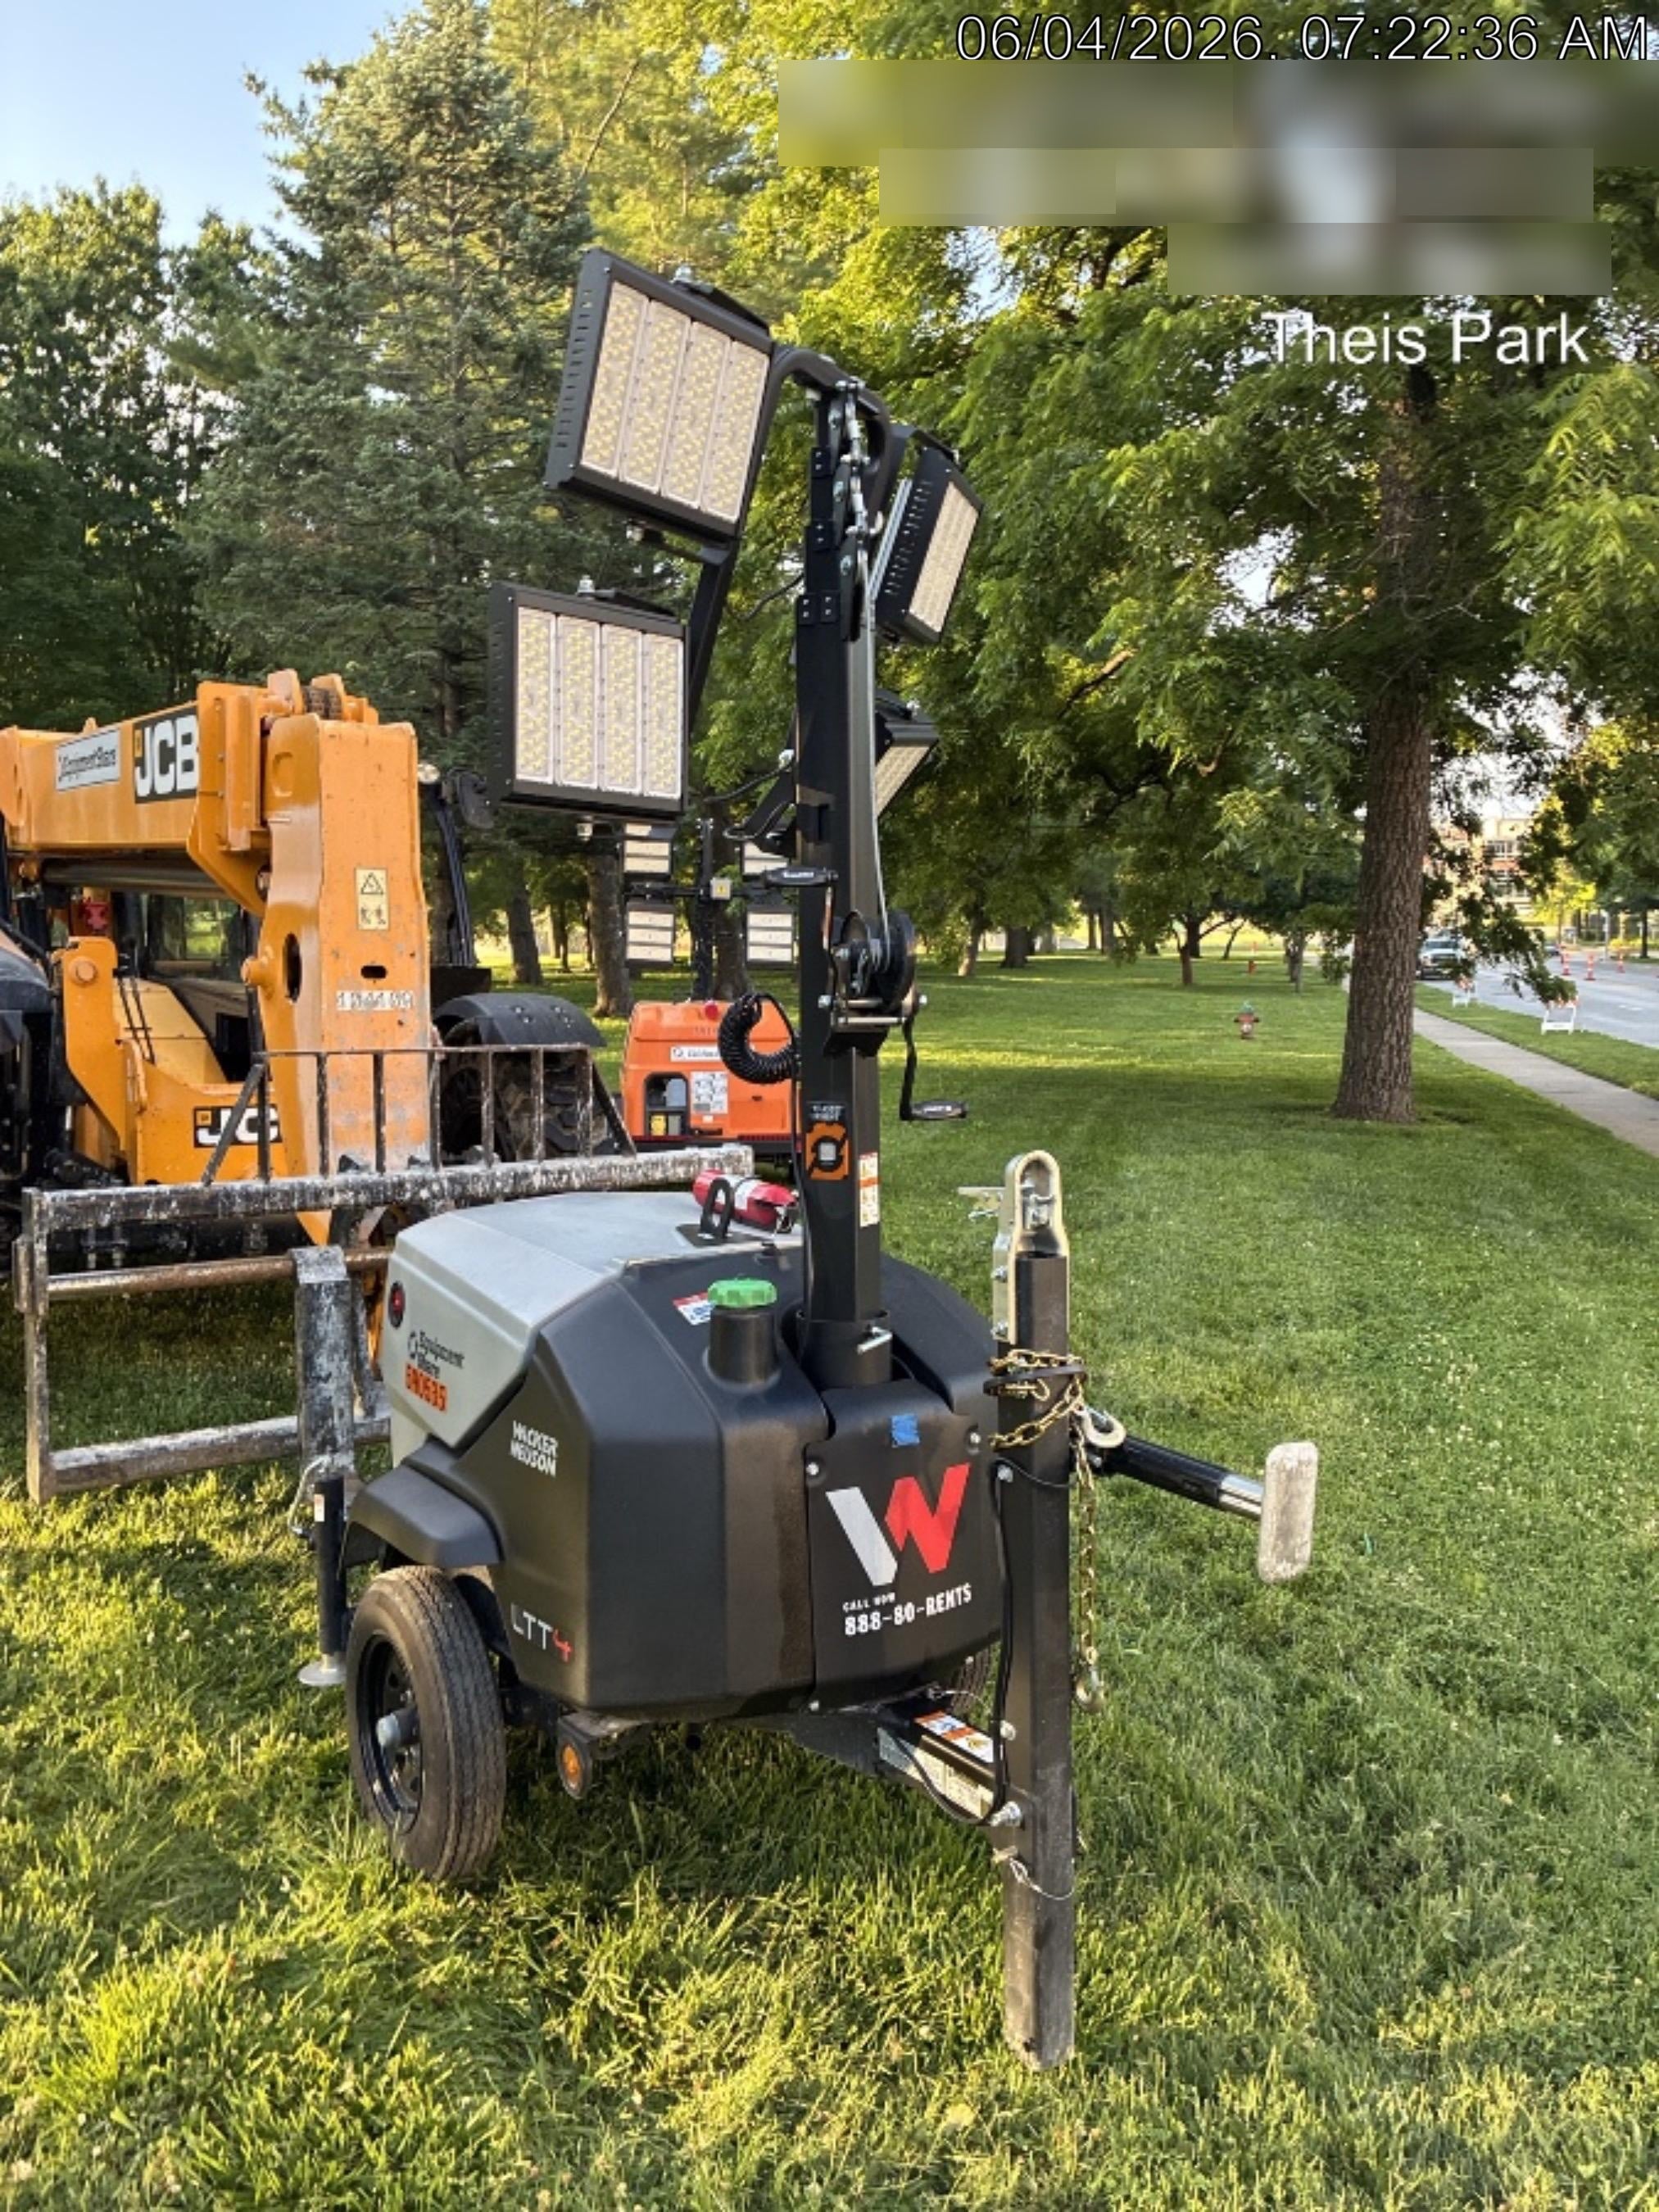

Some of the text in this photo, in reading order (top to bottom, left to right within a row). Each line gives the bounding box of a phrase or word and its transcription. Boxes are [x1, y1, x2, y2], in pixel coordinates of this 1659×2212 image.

[134, 714, 198, 797] JCB
[197, 1108, 279, 1145] JC
[513, 1420, 559, 1458] WACKER
[510, 1602, 573, 1663] LTT4
